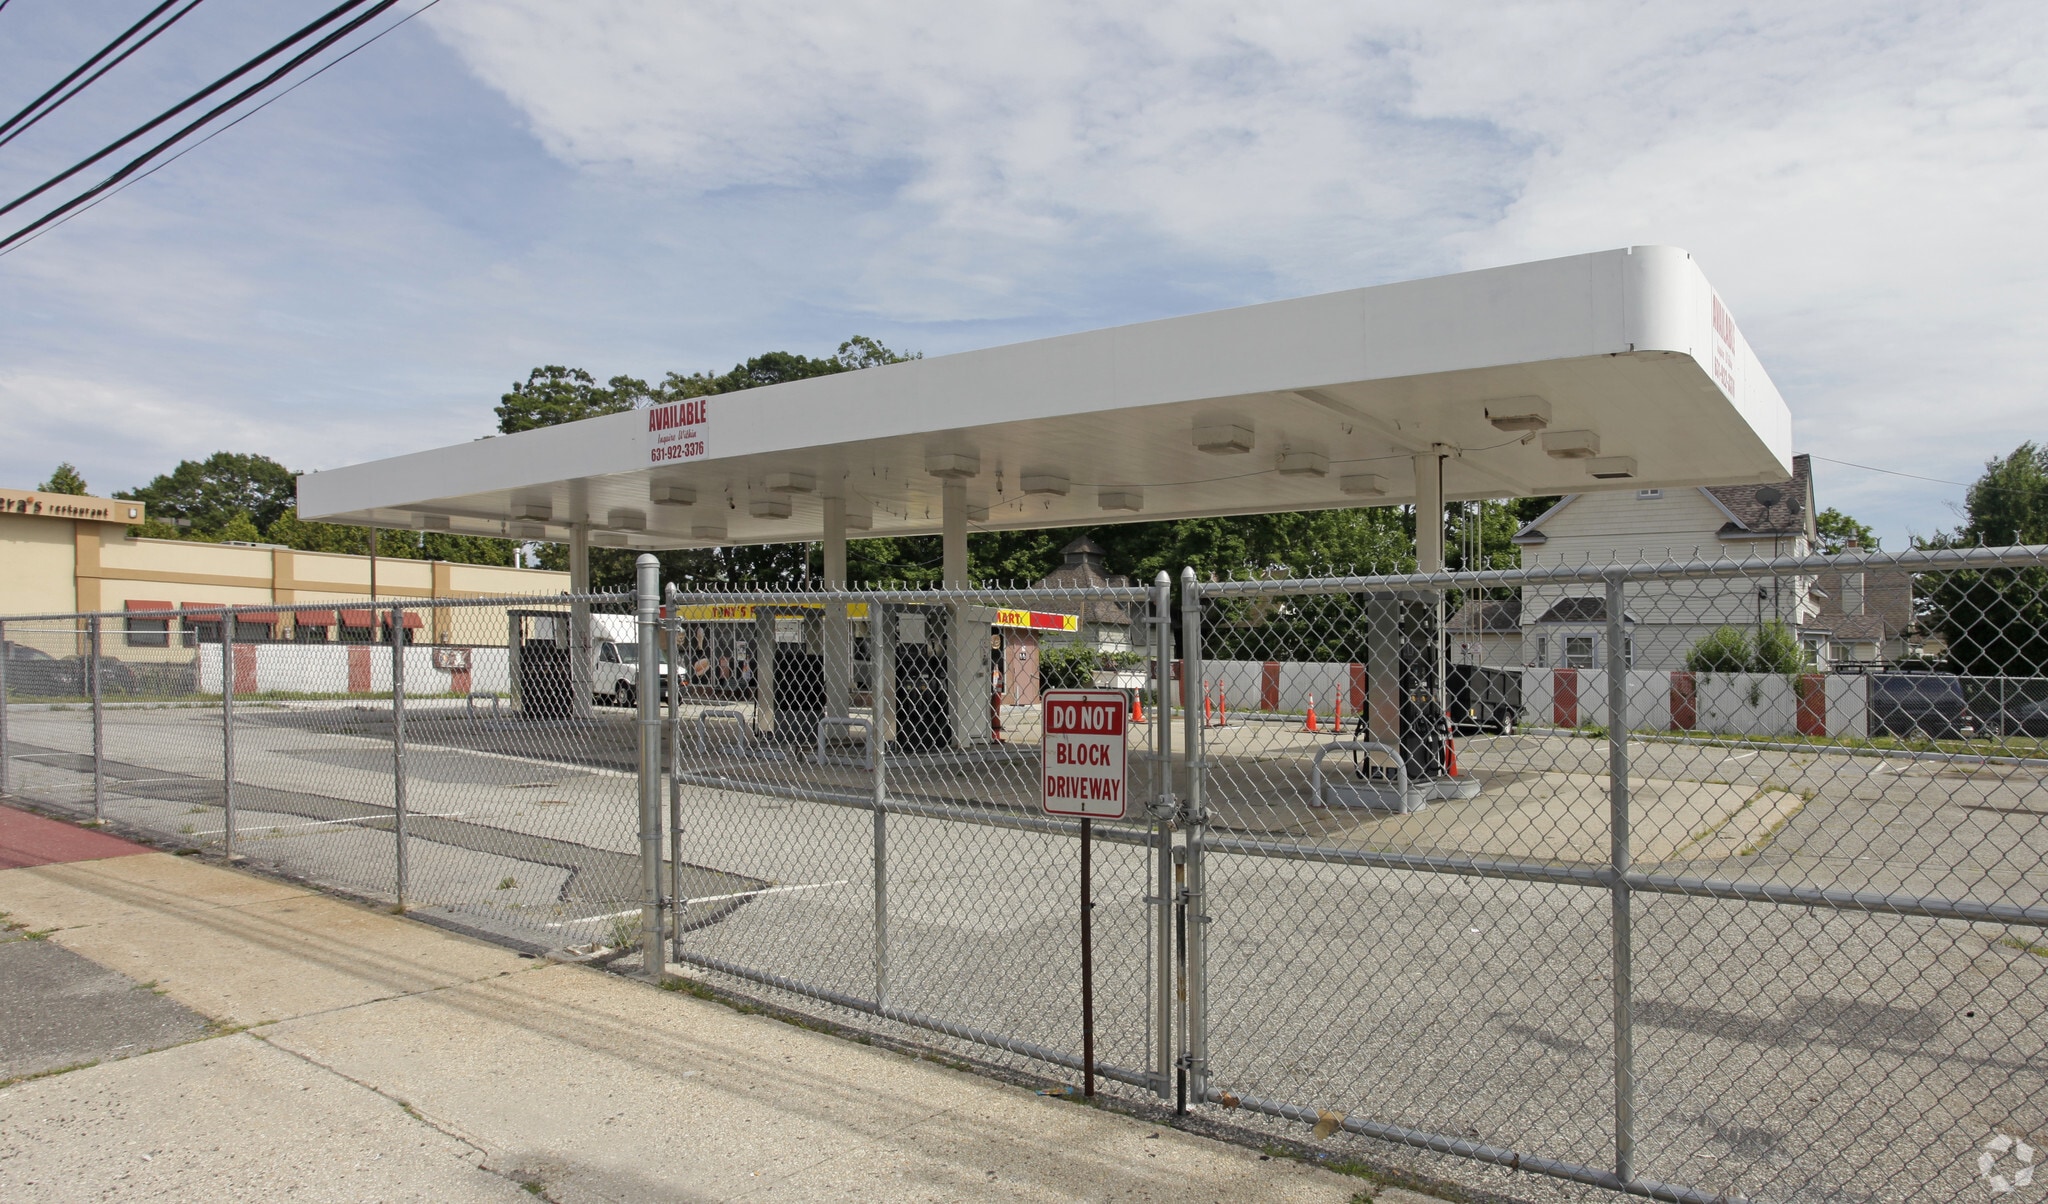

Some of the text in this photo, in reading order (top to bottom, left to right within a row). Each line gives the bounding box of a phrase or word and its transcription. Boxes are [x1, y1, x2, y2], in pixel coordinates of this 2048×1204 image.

[649, 400, 706, 432] AVAILABLE
[651, 441, 704, 462] 631-922-3376
[49, 504, 108, 518] restaurant
[1053, 706, 1115, 730] DO NOT
[1056, 743, 1110, 766] BLOCK
[1047, 775, 1120, 801] DRIVEWAY
